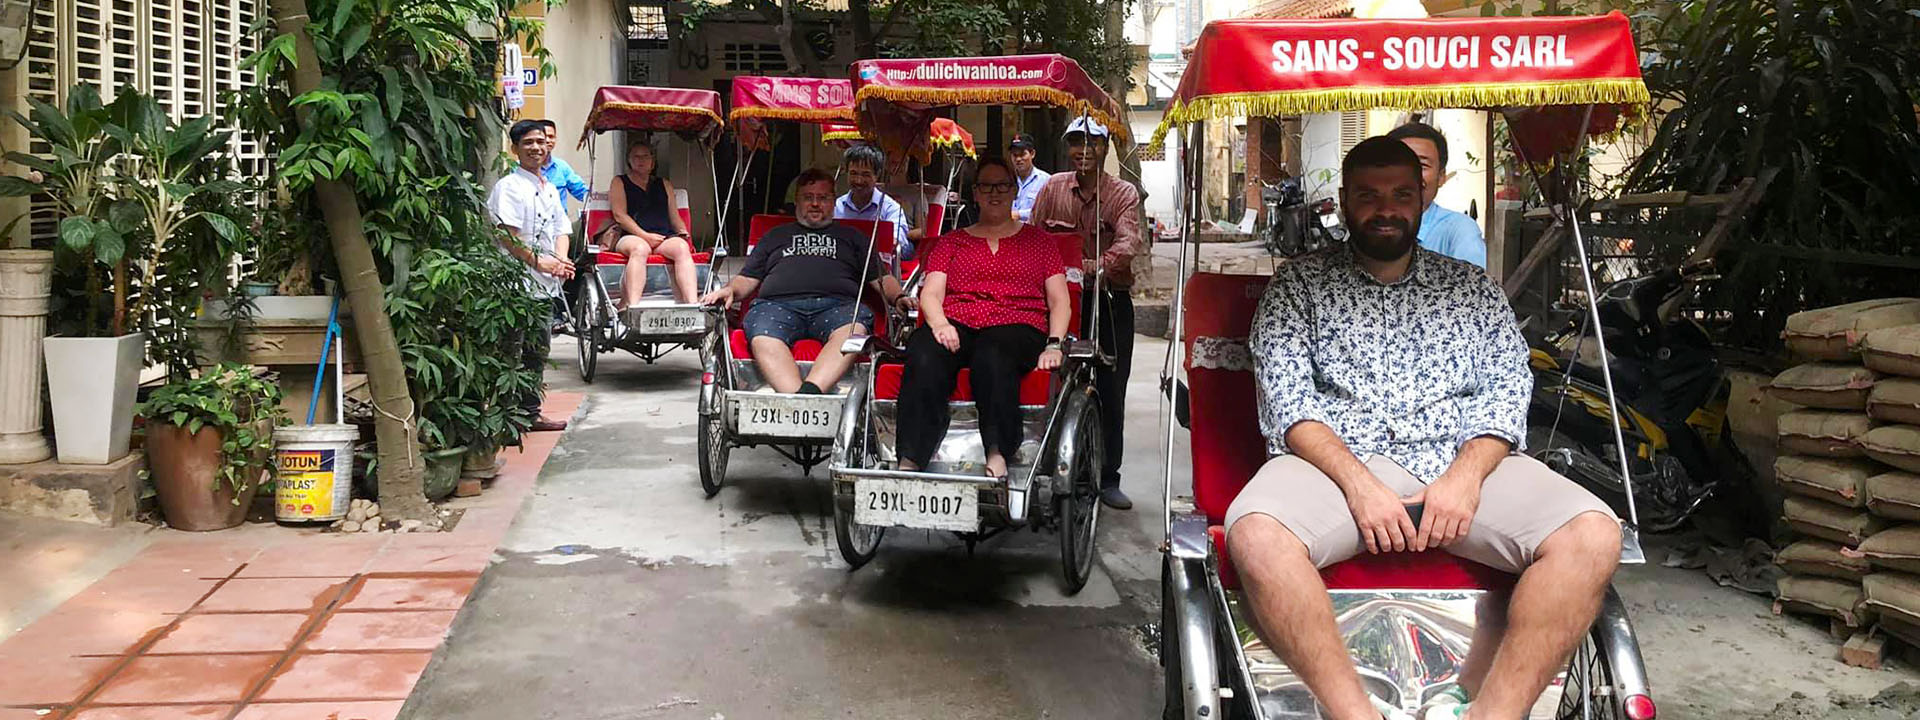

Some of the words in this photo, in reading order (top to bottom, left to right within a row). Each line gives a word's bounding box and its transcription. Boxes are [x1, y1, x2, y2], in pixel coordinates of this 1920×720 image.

[1383, 36, 1480, 70] SOUCI
[1490, 35, 1574, 67] SARL
[760, 83, 811, 105] SANS
[751, 408, 830, 426] 29XL-0053
[868, 491, 962, 515] 29XL-0007
